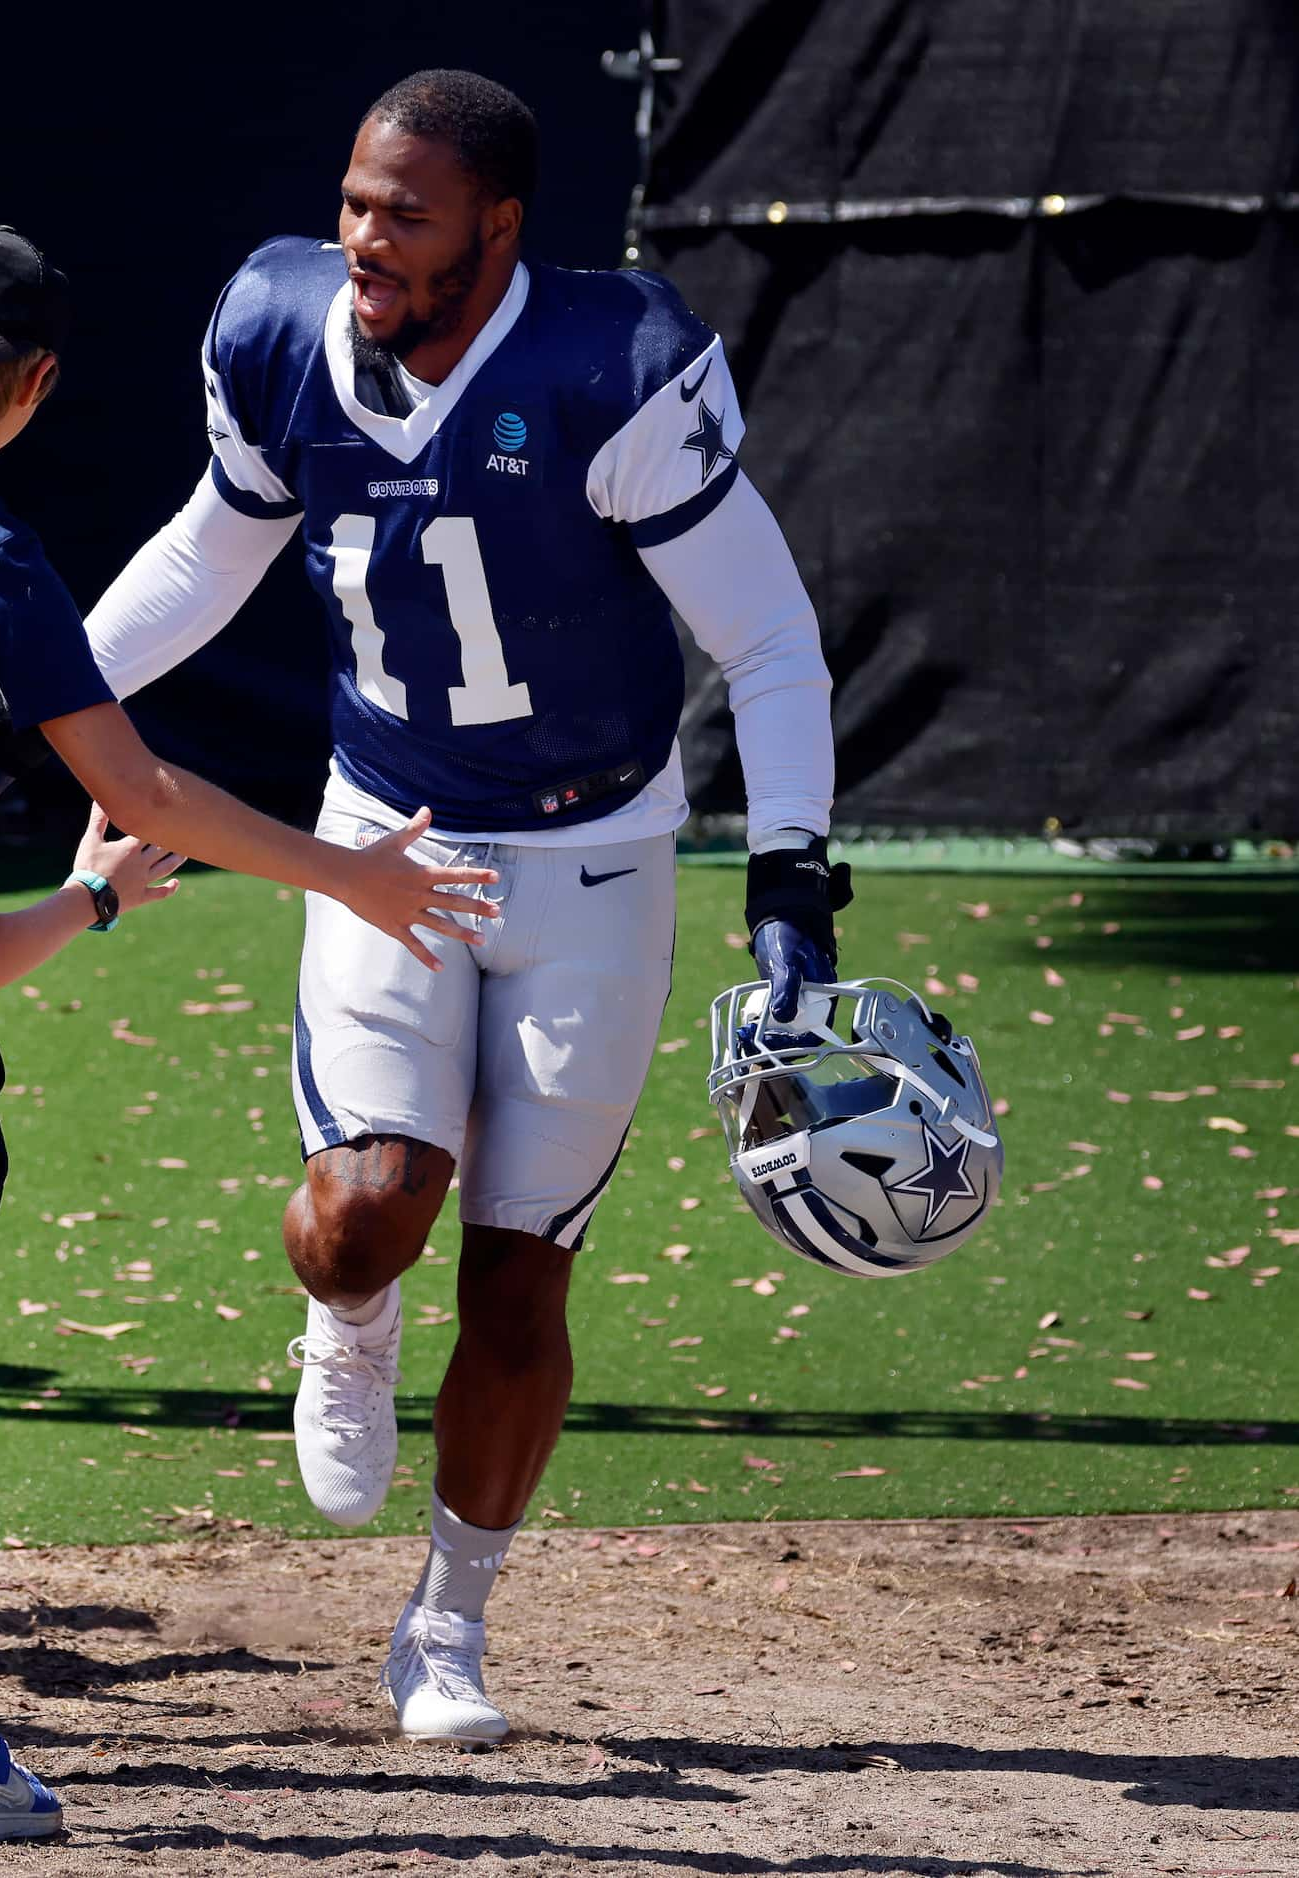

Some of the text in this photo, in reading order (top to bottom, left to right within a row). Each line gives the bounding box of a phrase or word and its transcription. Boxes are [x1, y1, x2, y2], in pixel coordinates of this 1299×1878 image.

[486, 454, 530, 475] AT&T
[368, 478, 439, 498] COWBOYS
[326, 513, 534, 727] 11
[751, 1152, 798, 1178] COWBOYS
